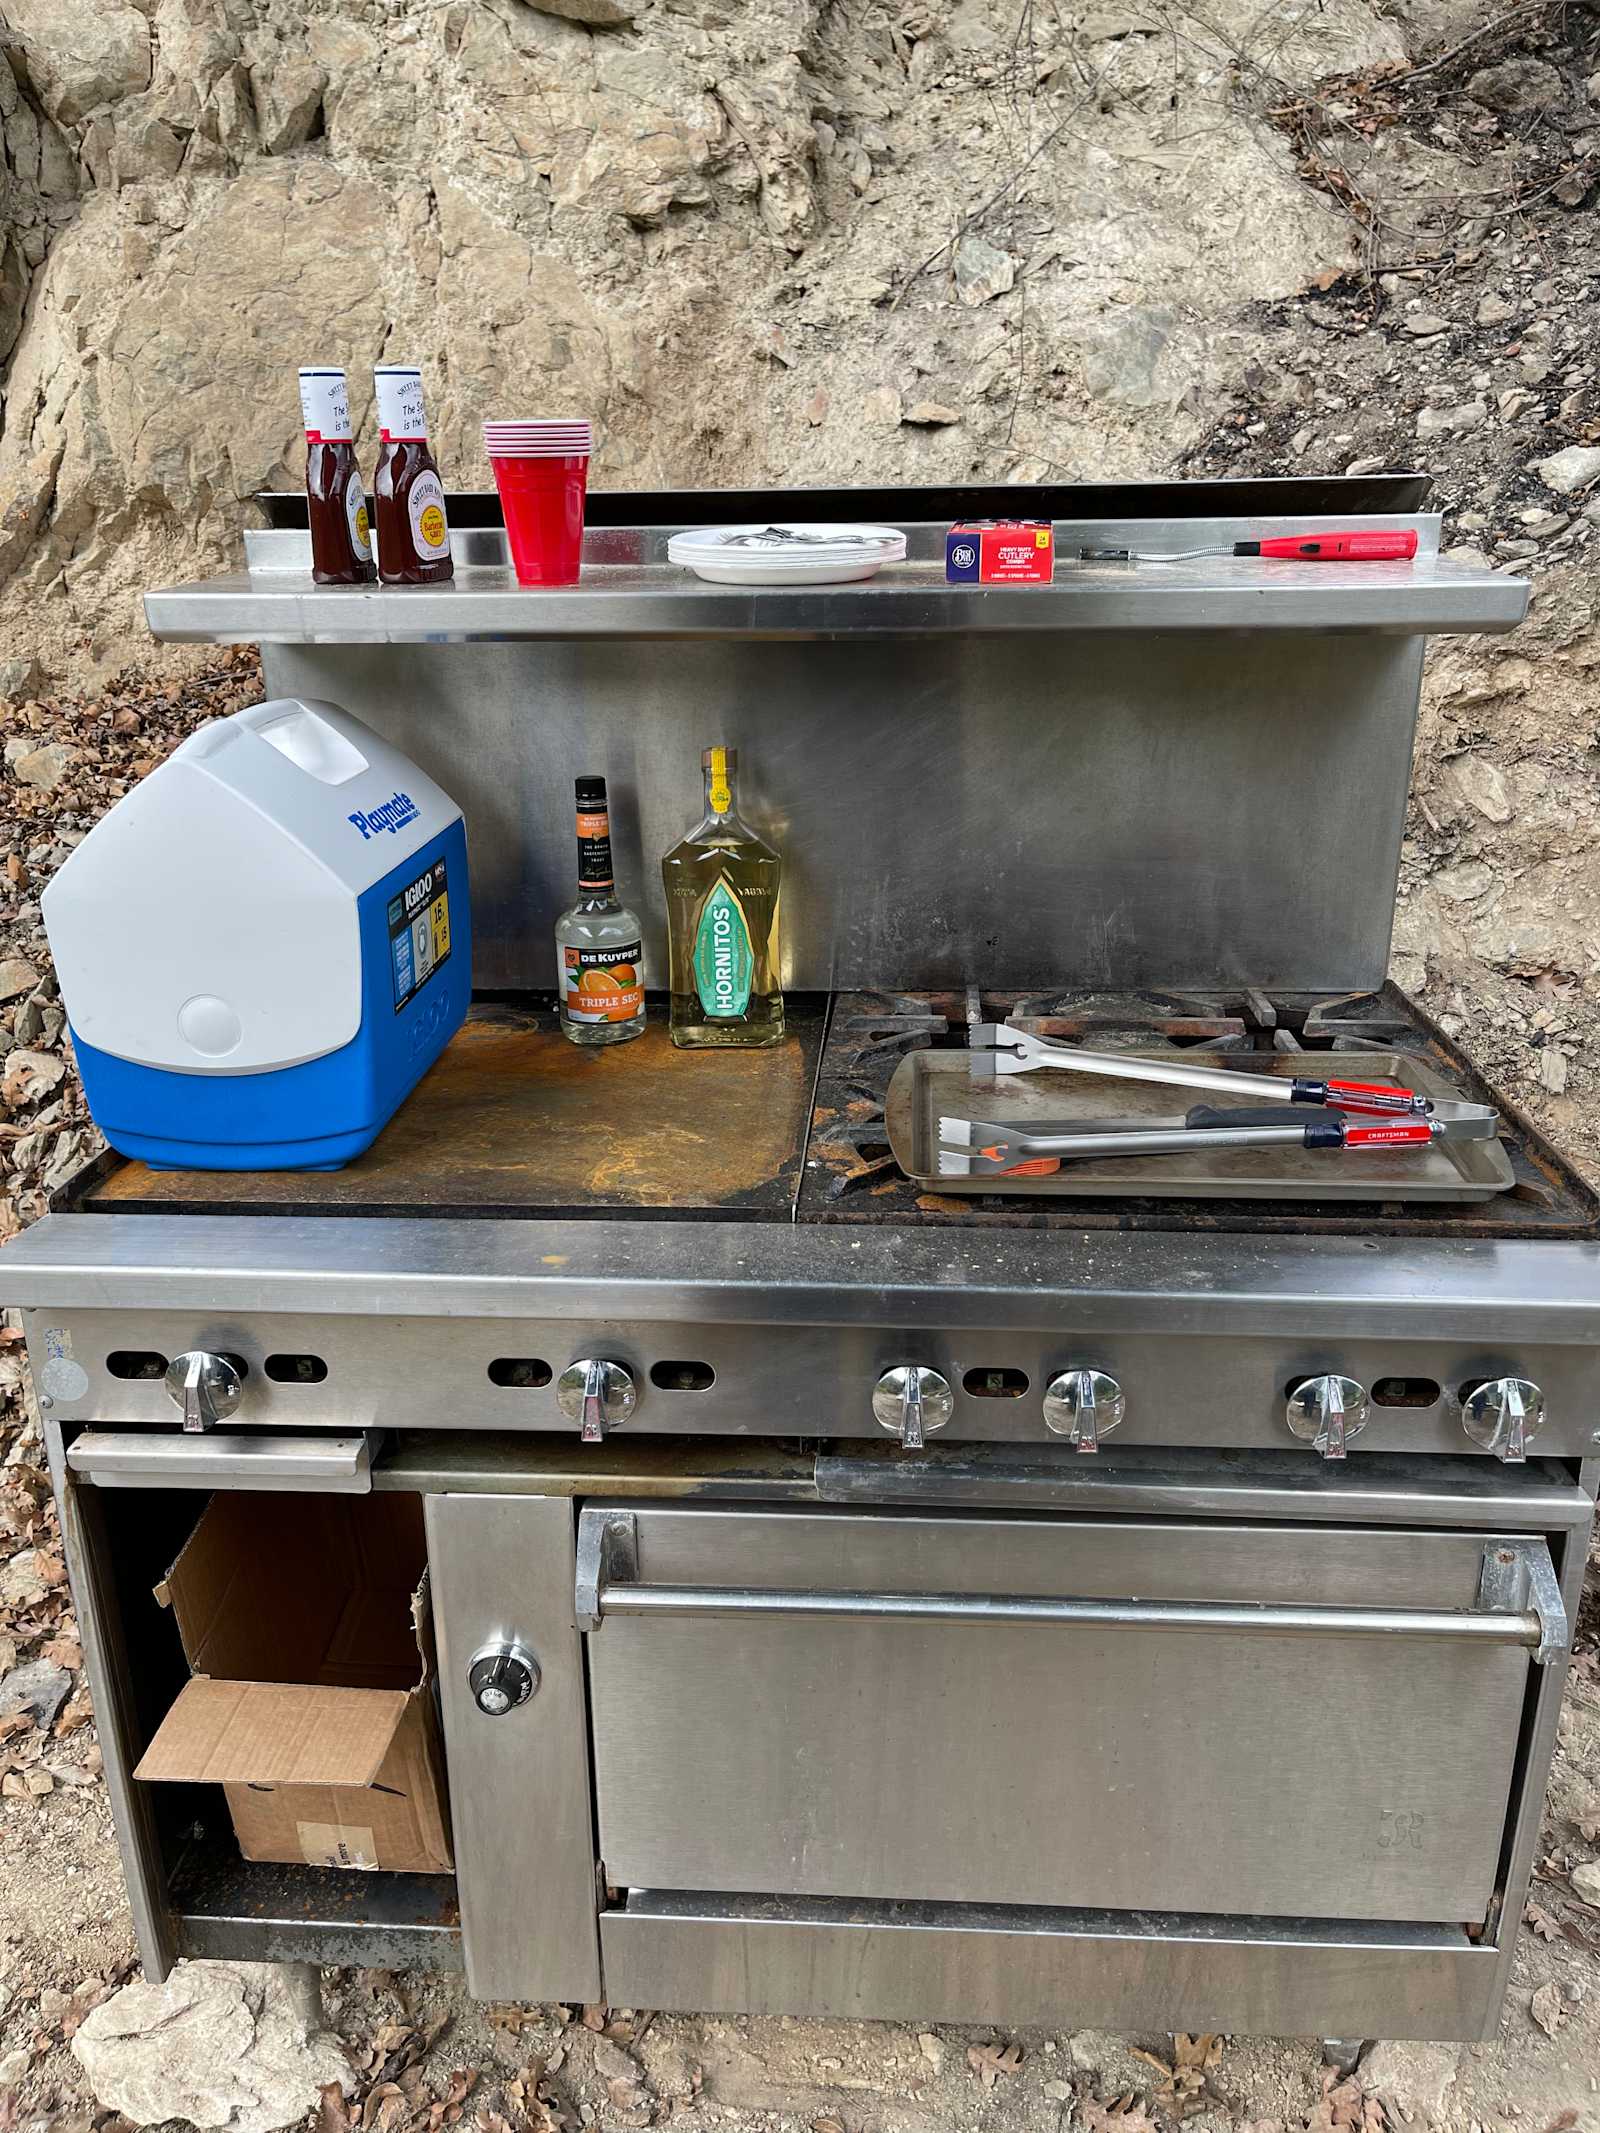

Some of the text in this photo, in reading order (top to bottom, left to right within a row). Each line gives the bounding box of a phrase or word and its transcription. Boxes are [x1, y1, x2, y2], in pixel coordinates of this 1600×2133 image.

[402, 404, 416, 416] The
[403, 420, 410, 430] is
[998, 552, 1035, 560] CUTLERY
[347, 792, 415, 840] Playmate
[581, 948, 639, 963] DE KUYPER
[713, 907, 734, 1009] HORNITOS
[579, 991, 639, 1008] TRIPLE SEC
[1367, 1131, 1409, 1140] CRAFTSMAN
